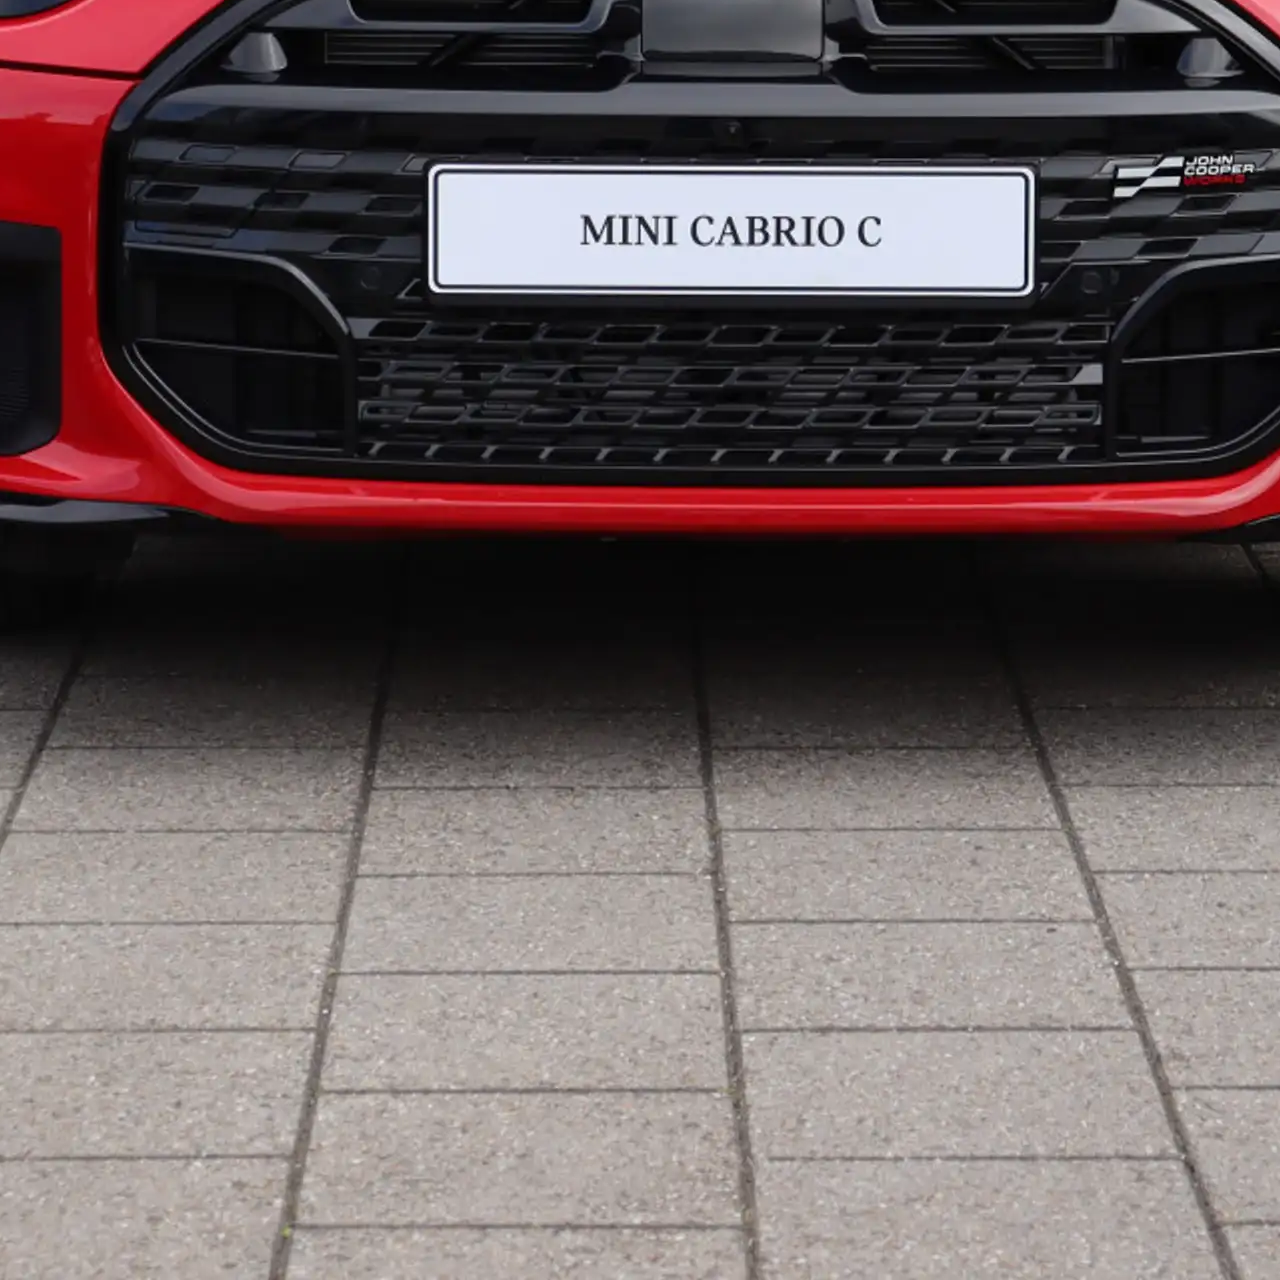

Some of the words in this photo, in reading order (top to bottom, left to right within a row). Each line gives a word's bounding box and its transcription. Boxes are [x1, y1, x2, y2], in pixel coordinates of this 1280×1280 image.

[1185, 154, 1234, 166] JOHN
[1184, 164, 1255, 176] COOPER
[581, 216, 676, 245] MINI
[691, 216, 844, 246] CABRIO
[858, 216, 881, 247] C
